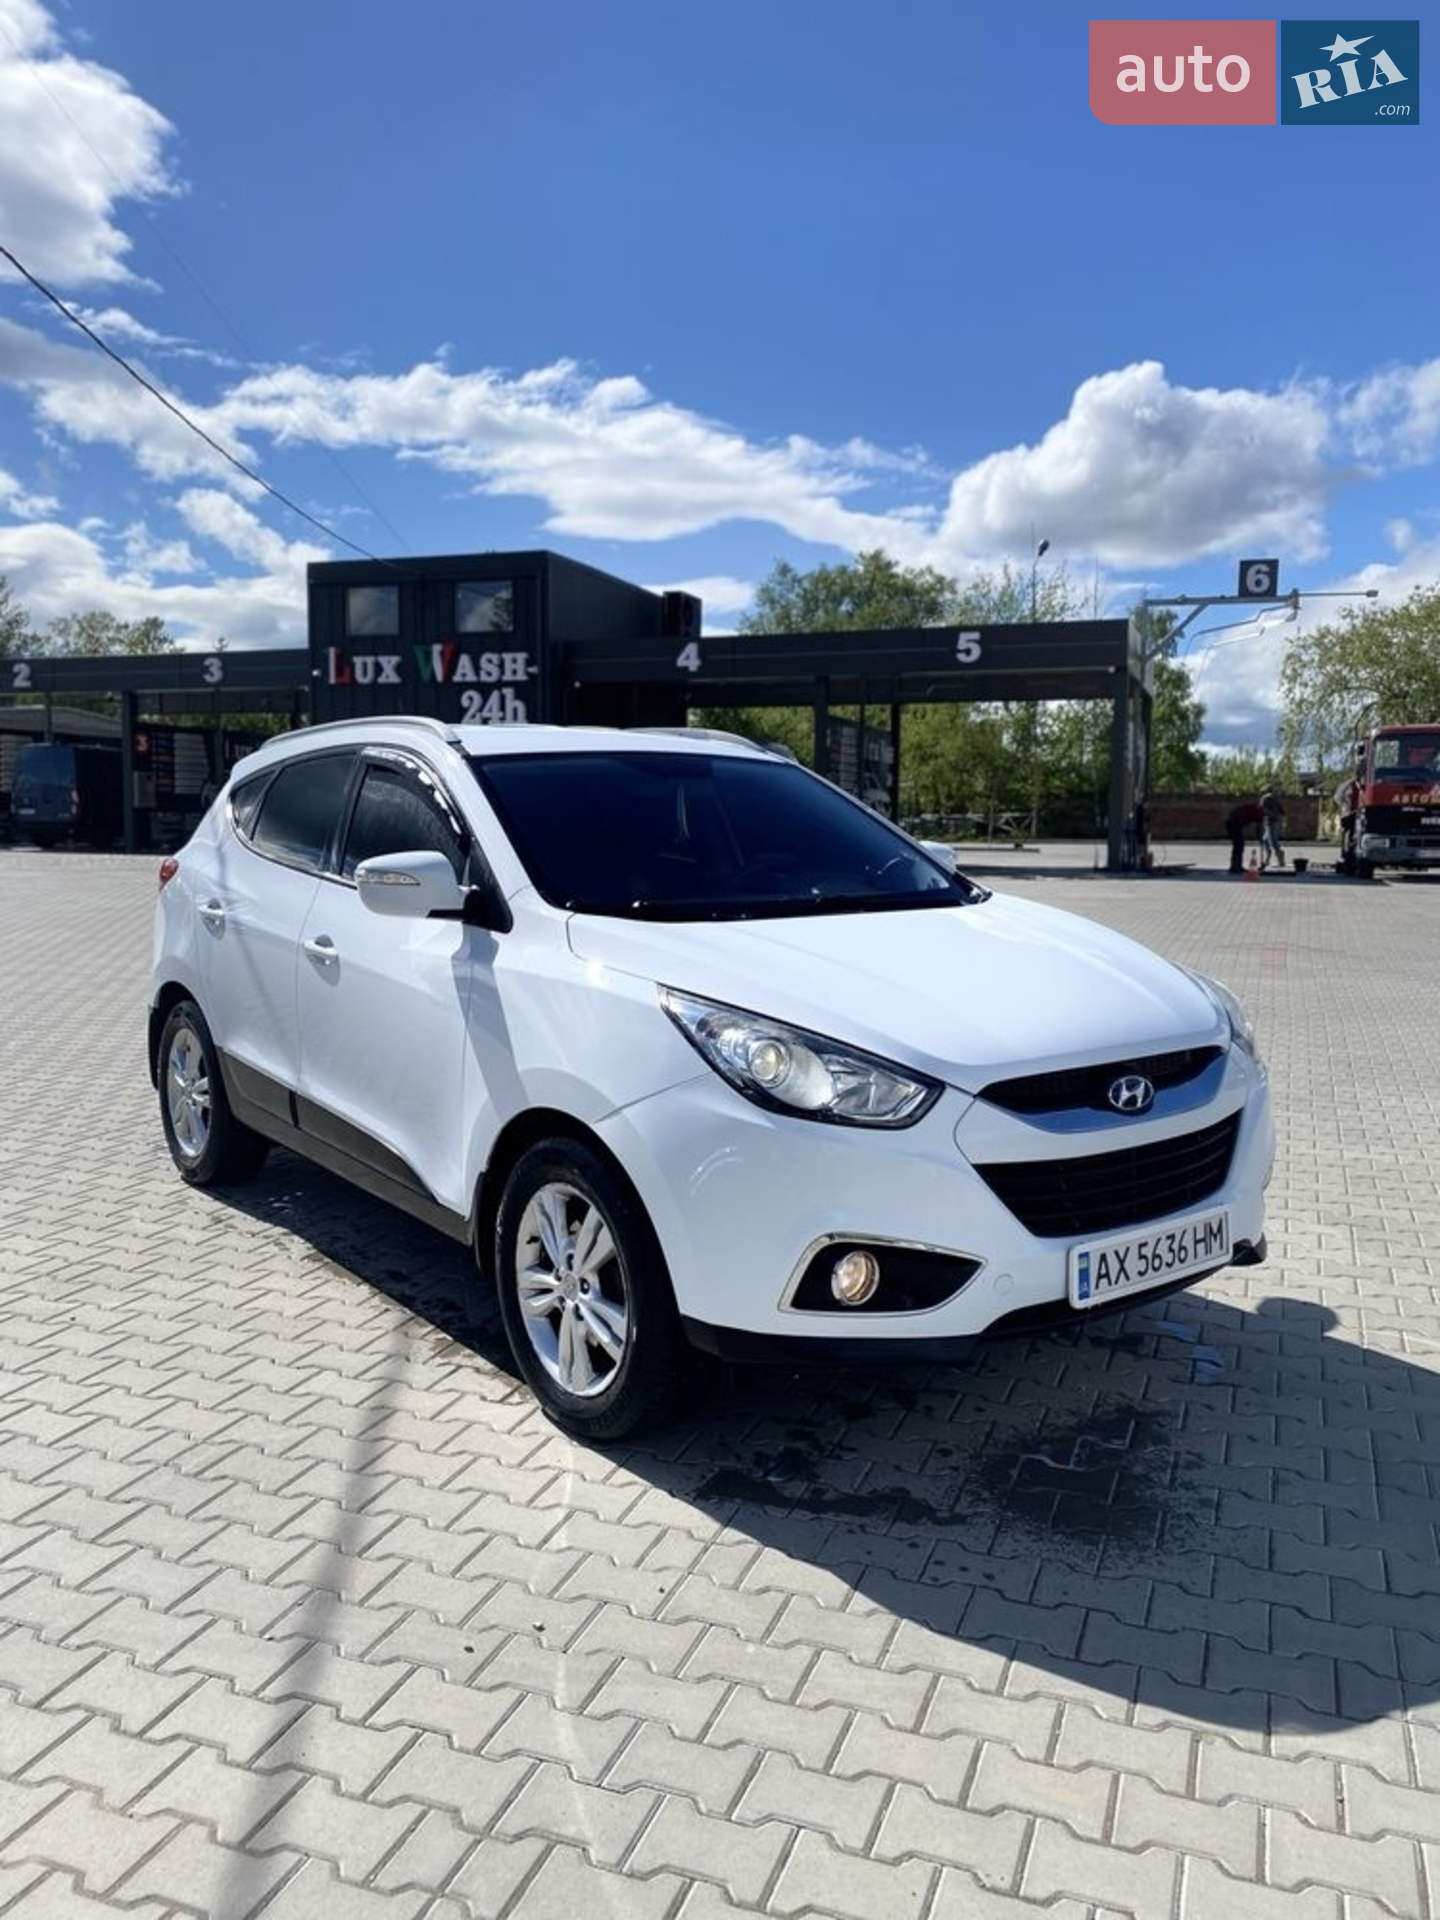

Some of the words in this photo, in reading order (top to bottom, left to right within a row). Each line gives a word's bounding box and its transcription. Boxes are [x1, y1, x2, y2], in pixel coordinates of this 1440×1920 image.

[1245, 563, 1271, 594] 6
[676, 642, 702, 672] 4
[955, 631, 982, 664] 5
[12, 663, 32, 688] 2
[202, 657, 224, 683] 3
[460, 687, 528, 725] 24h
[1096, 1246, 1131, 1290] AX
[1137, 1228, 1189, 1277] 5636
[1193, 1217, 1225, 1260] HM
